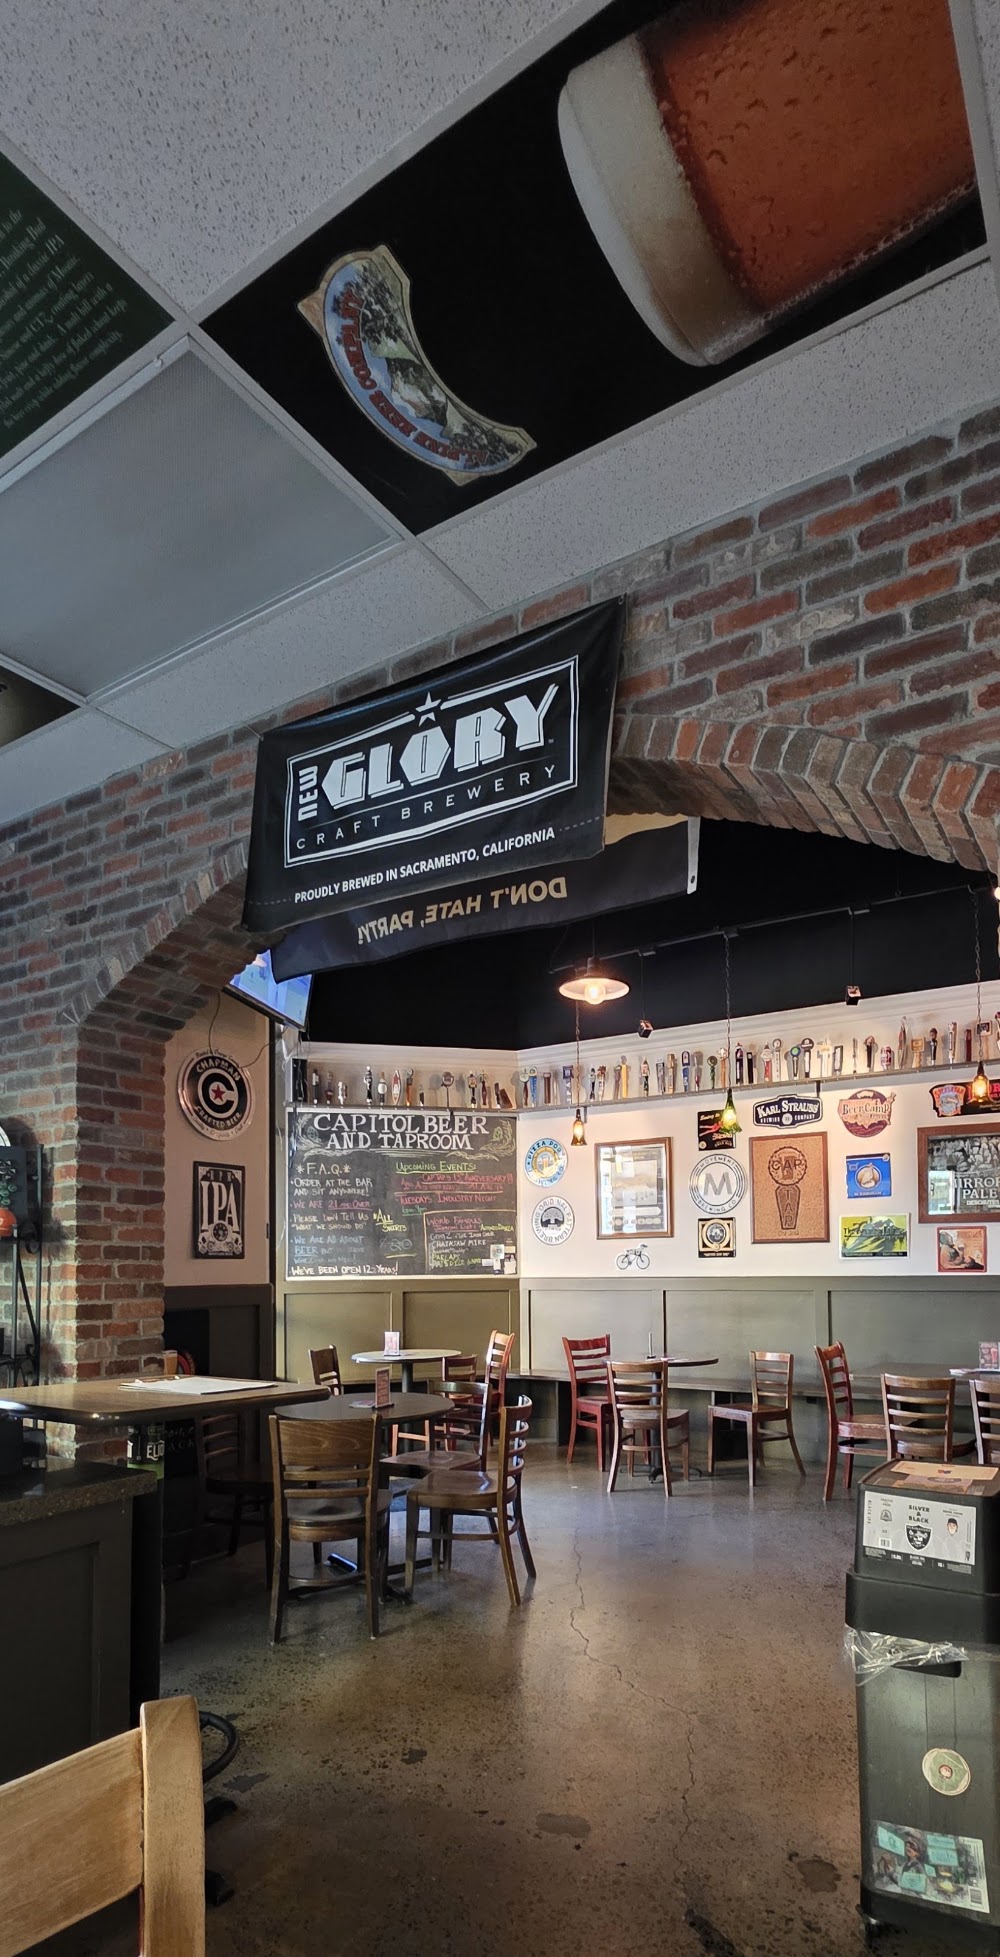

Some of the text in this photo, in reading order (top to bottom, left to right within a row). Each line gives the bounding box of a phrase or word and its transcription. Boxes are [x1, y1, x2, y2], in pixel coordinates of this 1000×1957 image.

[25, 217, 46, 240] Bud
[45, 234, 65, 256] IPA
[322, 683, 559, 811] GLORY
[295, 764, 556, 851] CRAFT BREWERY
[293, 826, 556, 904] PROUDLY BREWED IN SACRAMENTO, CALIFORNIA
[196, 1058, 241, 1082] CHAPMAN
[194, 1105, 226, 1129] CRAFTED
[756, 1100, 820, 1119] KARL STRAUSS
[313, 1113, 490, 1135] CAPITOL BEER
[325, 1131, 475, 1150] AND TAPROOM
[527, 1140, 546, 1160] PIZZA
[699, 1155, 735, 1168] MOVEMENT
[771, 1158, 802, 1171] CAP
[325, 1179, 335, 1187] AT
[338, 1179, 352, 1187] THE
[355, 1177, 373, 1187] BAR
[703, 1172, 733, 1196] M
[293, 1188, 309, 1197] AND
[311, 1188, 326, 1196] SIT
[962, 1189, 999, 1200] PALE
[200, 1180, 240, 1232] IPA
[293, 1201, 304, 1209] WE
[308, 1200, 324, 1209] ARE
[328, 1200, 337, 1209] 21
[697, 1199, 726, 1212] BREWING
[784, 1189, 794, 1227] TAP
[294, 1245, 318, 1255] BEER
[318, 1265, 339, 1274] BEEN
[341, 1265, 361, 1274] OPEN
[908, 1504, 930, 1513] SILVER
[908, 1515, 929, 1524] BLACK
